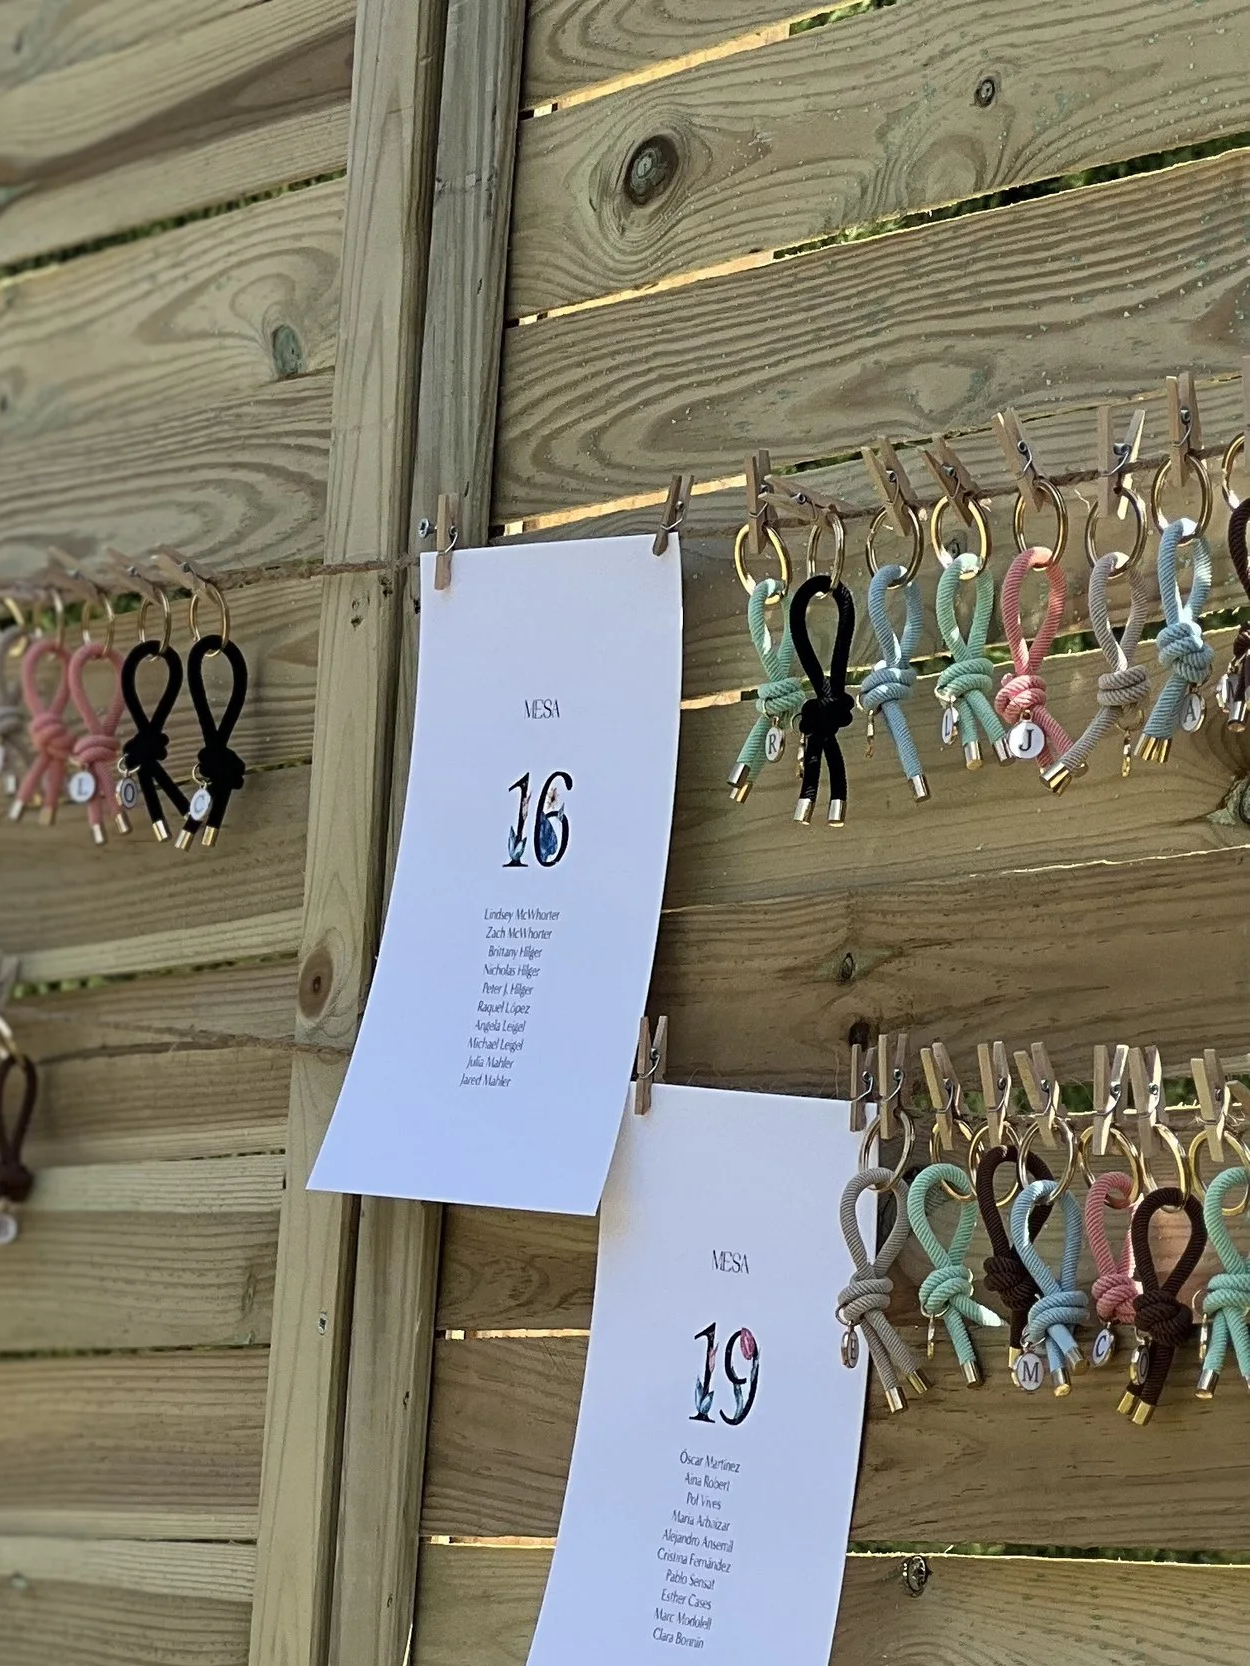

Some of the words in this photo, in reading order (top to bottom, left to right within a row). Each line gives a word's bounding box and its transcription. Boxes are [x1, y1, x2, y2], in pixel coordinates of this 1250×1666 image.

[524, 699, 560, 719] MESA
[1183, 699, 1196, 722] A
[768, 734, 778, 754] R
[1018, 729, 1034, 751] J
[77, 778, 88, 796] L
[124, 783, 135, 803] O
[194, 795, 204, 813] C
[502, 771, 573, 867] 16
[484, 908, 514, 923] Lindsey
[516, 908, 560, 921] McWhorter
[486, 926, 506, 939] Zach
[508, 927, 552, 939] McWhorter
[488, 945, 518, 959] Brittany
[519, 945, 542, 960] Hilger
[484, 964, 516, 976] Nicholas
[517, 964, 540, 978] Hilger
[482, 982, 502, 994] Peter
[503, 983, 508, 996] J.
[511, 983, 534, 997] Hilger
[477, 1001, 504, 1015] Raquel
[505, 1001, 530, 1015] López
[475, 1019, 500, 1033] Angela
[502, 1020, 526, 1035] Leigel
[468, 1037, 499, 1050] Michael
[500, 1038, 524, 1053] Leigel
[466, 1056, 484, 1069] Julia
[486, 1057, 514, 1069] Mahler
[460, 1073, 481, 1087] Jared
[484, 1075, 511, 1087] Mahler
[712, 1250, 749, 1274] MESA
[1095, 1335, 1106, 1356] C
[689, 1322, 761, 1426] 19
[1022, 1360, 1039, 1383] M
[679, 1448, 703, 1466] Óscar
[684, 1472, 702, 1486] Aina
[704, 1475, 730, 1491] Robert
[686, 1492, 699, 1505] Pol
[701, 1494, 722, 1510] Vives
[662, 1529, 700, 1548] Alejandro
[657, 1548, 688, 1564] Cristina
[666, 1569, 688, 1585] Pablo
[661, 1588, 686, 1605] Esther
[688, 1594, 712, 1610] Cases
[654, 1608, 675, 1623] Marc
[653, 1627, 674, 1643] Clara
